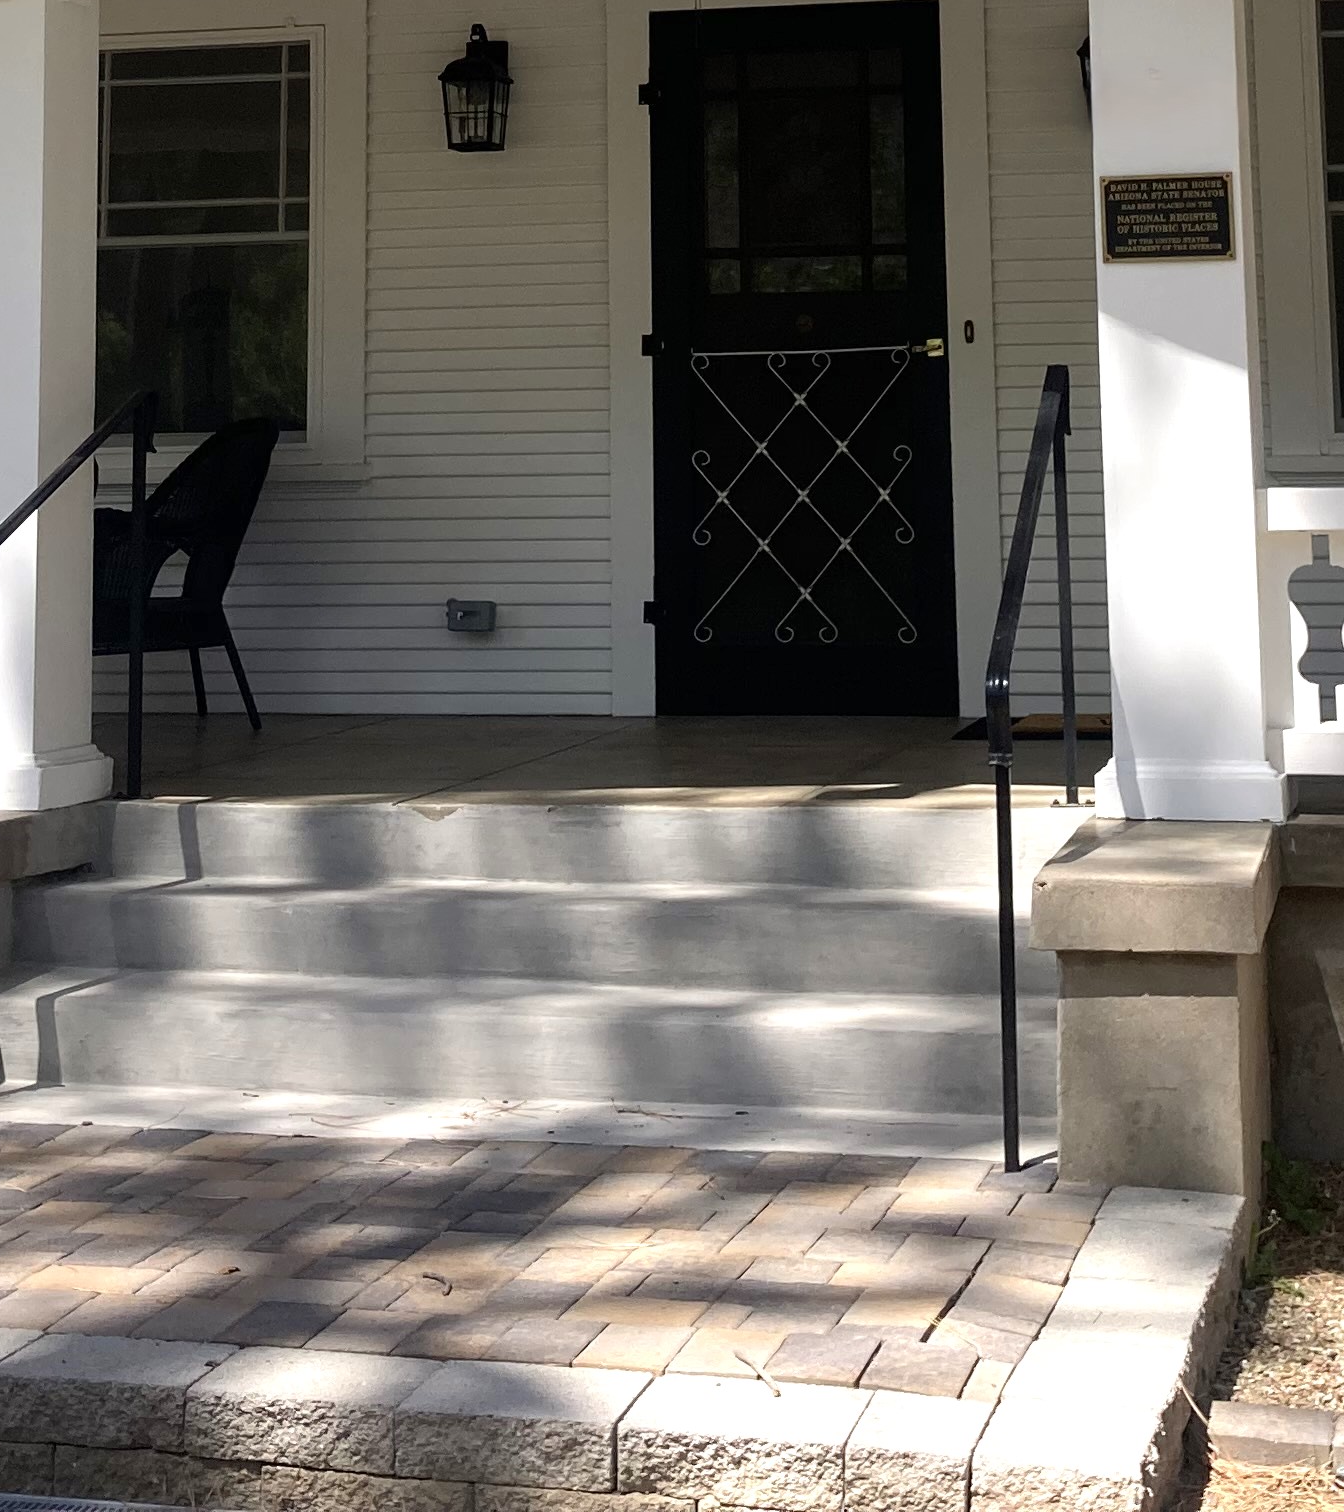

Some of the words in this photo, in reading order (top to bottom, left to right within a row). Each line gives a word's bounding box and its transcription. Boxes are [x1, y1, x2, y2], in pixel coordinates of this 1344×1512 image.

[1110, 184, 1136, 192] DAVID
[1153, 182, 1188, 190] PALMER
[1192, 180, 1222, 189] HOUSE
[1108, 192, 1148, 201] ARIZONA
[1151, 191, 1180, 199] STATE
[1183, 189, 1225, 198] SENATOR
[1117, 214, 1166, 224] NATIONAL
[1169, 212, 1218, 222] REGISTER
[1117, 225, 1130, 234] OF
[1132, 224, 1179, 233] HISTORIC
[1181, 222, 1219, 232] PLACES
